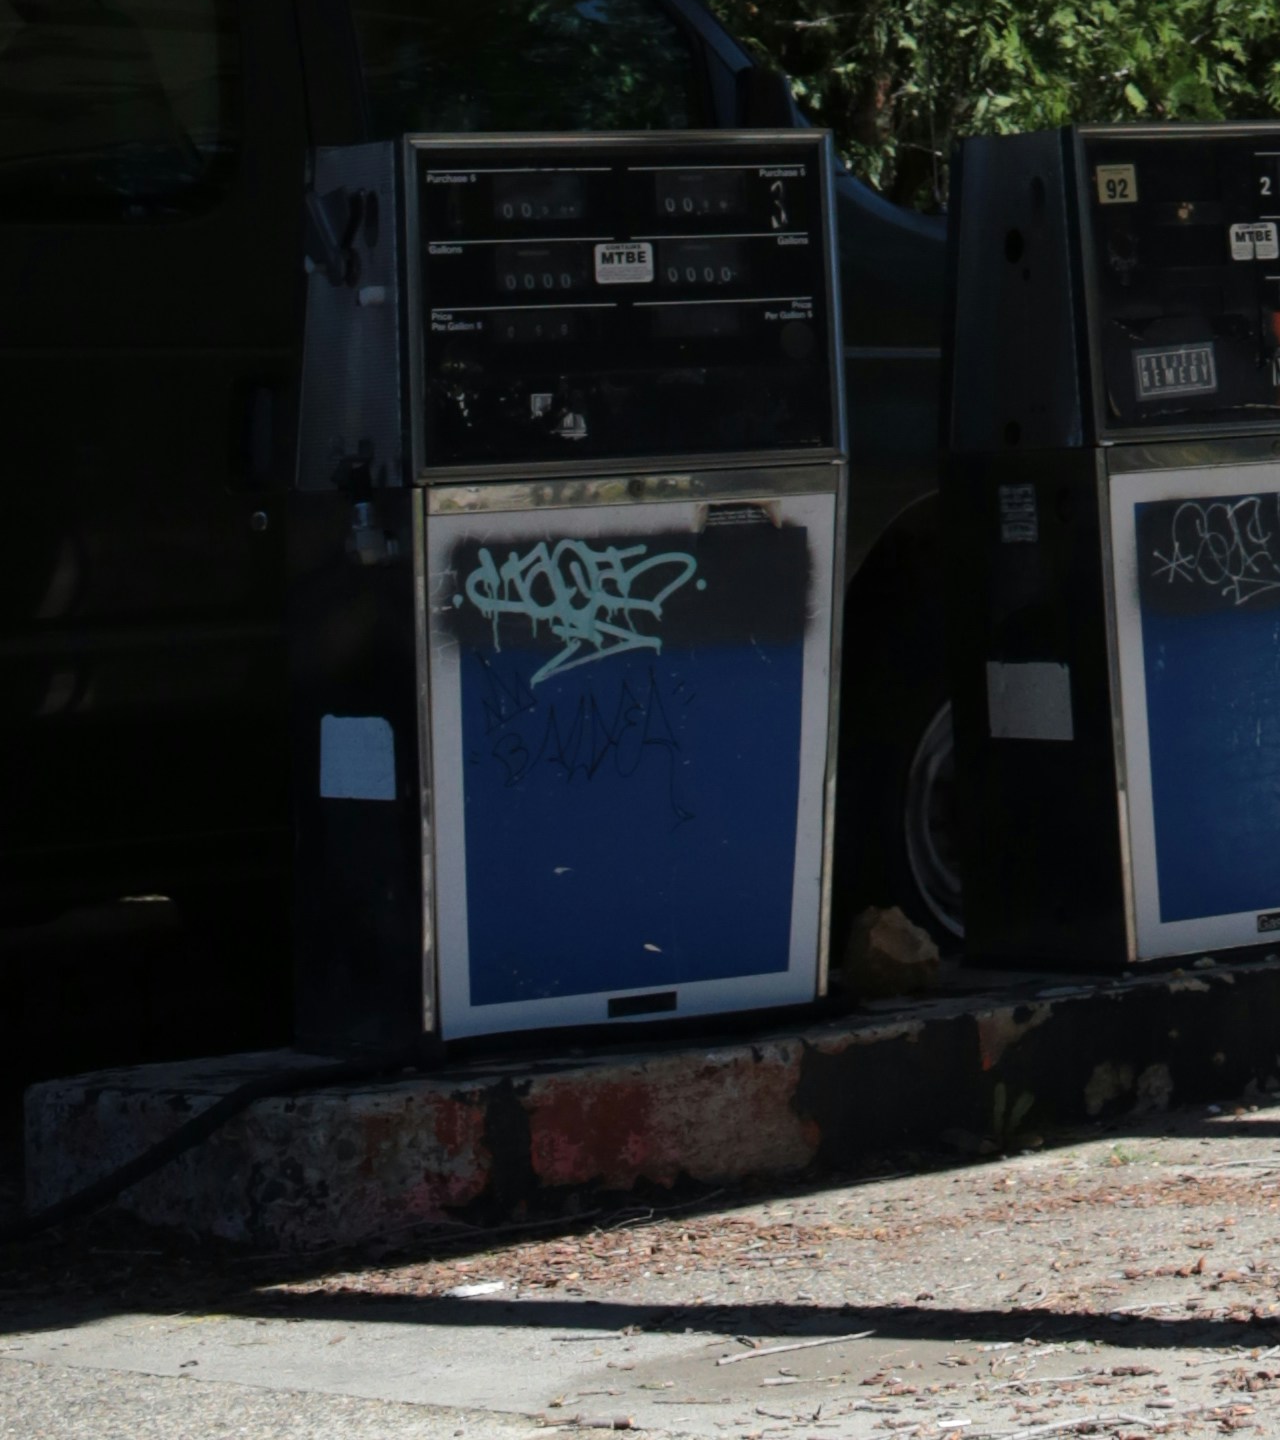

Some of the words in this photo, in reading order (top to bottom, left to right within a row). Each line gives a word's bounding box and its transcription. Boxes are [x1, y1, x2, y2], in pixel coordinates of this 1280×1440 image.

[426, 173, 468, 184] Purchase
[759, 168, 798, 178] Purchase
[1106, 178, 1129, 199] 92
[1259, 176, 1272, 195] 2
[777, 236, 809, 245] Gallons
[1235, 230, 1272, 242] MTBE
[428, 245, 463, 255] Gallons
[601, 251, 647, 264] MTBE
[431, 312, 453, 321] Price
[1141, 351, 1208, 369] PROJECT
[1142, 365, 1209, 387] REMEDY
